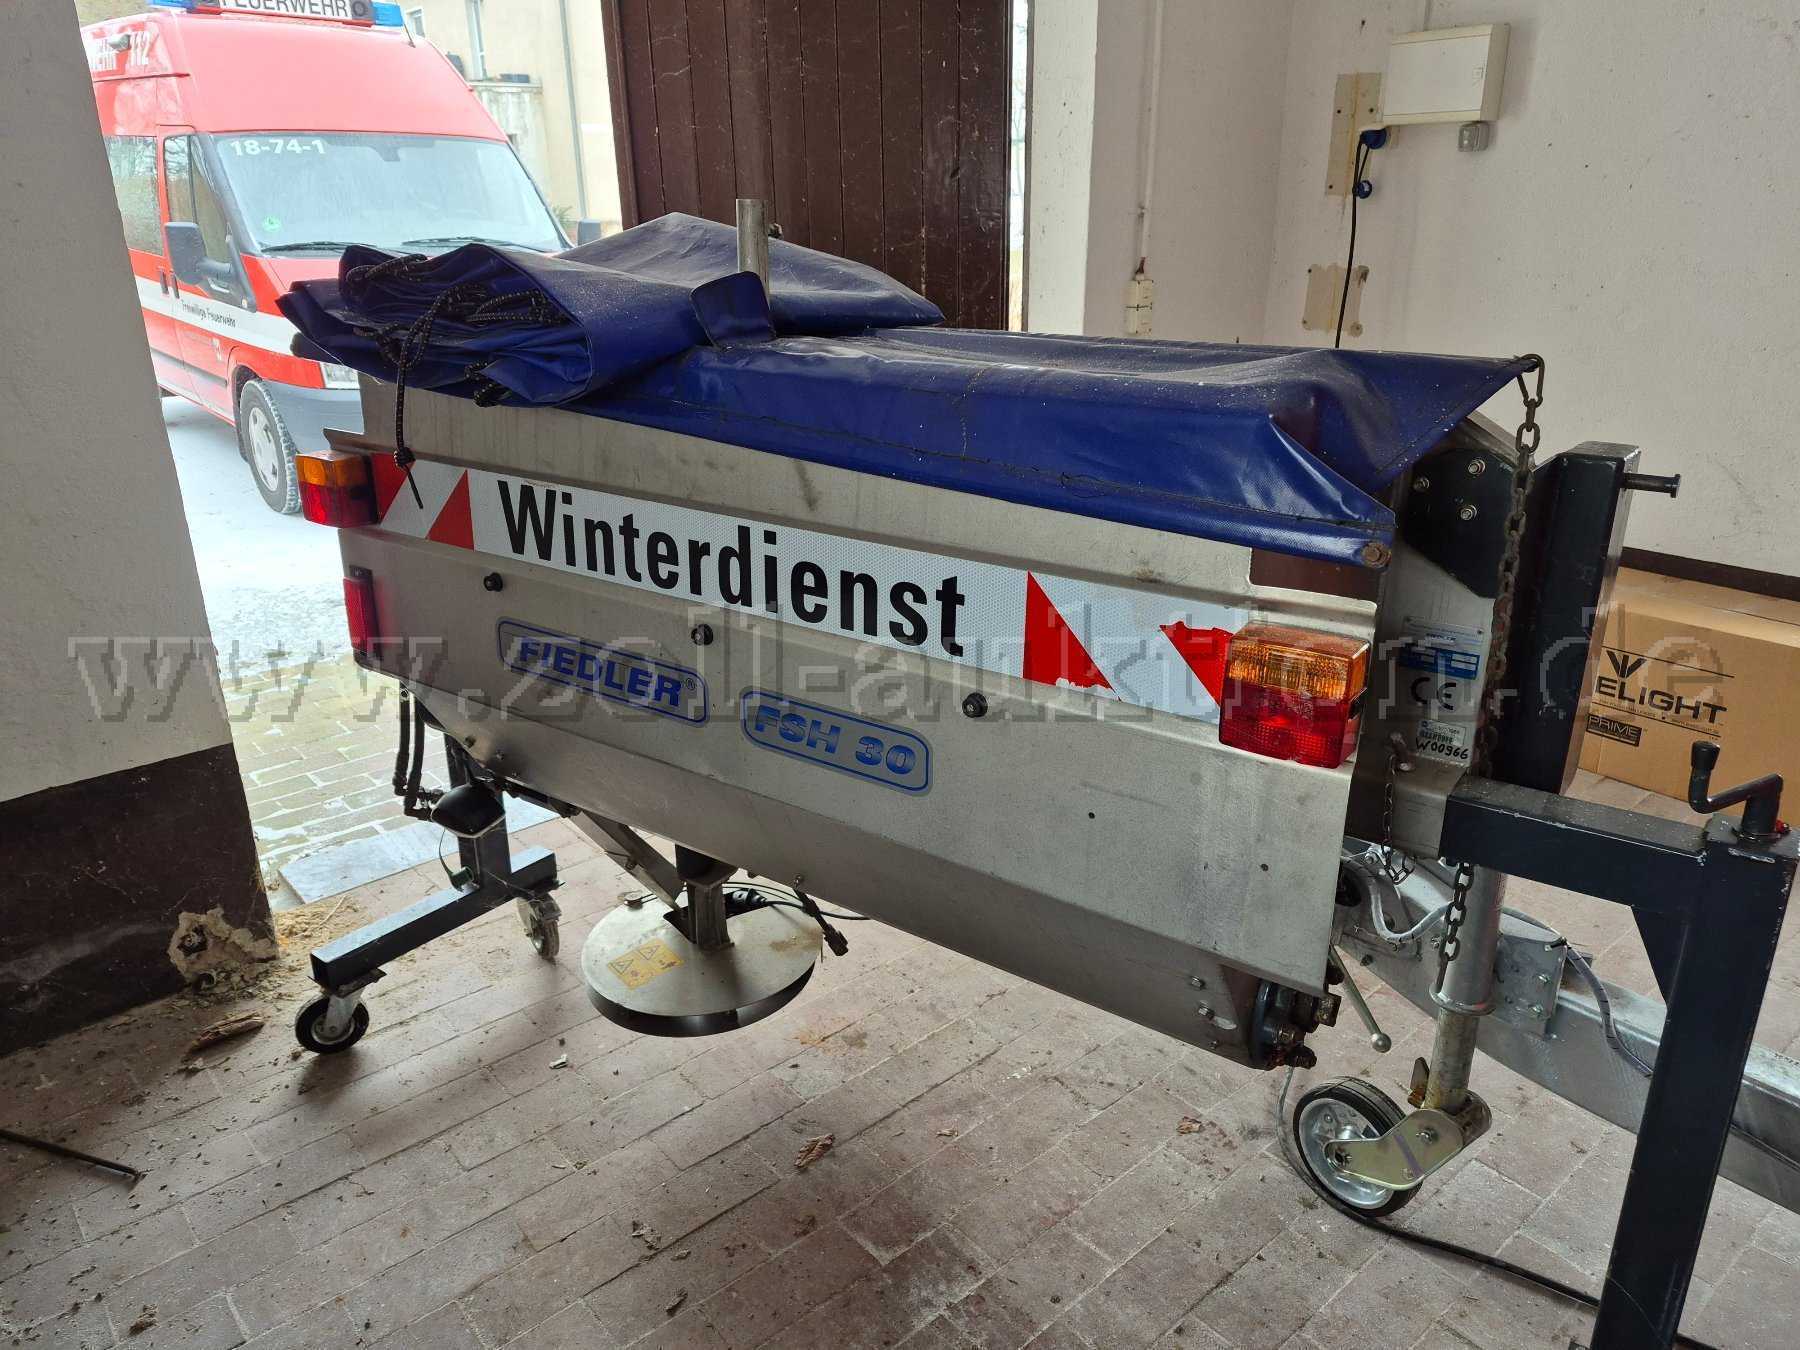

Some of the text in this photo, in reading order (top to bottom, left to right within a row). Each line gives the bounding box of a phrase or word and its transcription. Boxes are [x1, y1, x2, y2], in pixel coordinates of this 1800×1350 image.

[230, 138, 327, 157] 18-74-1
[497, 480, 966, 657] Winterdienst
[1587, 714, 1639, 739] PRIME
[753, 704, 917, 776] FSH 30
[1415, 737, 1469, 760] W00966
